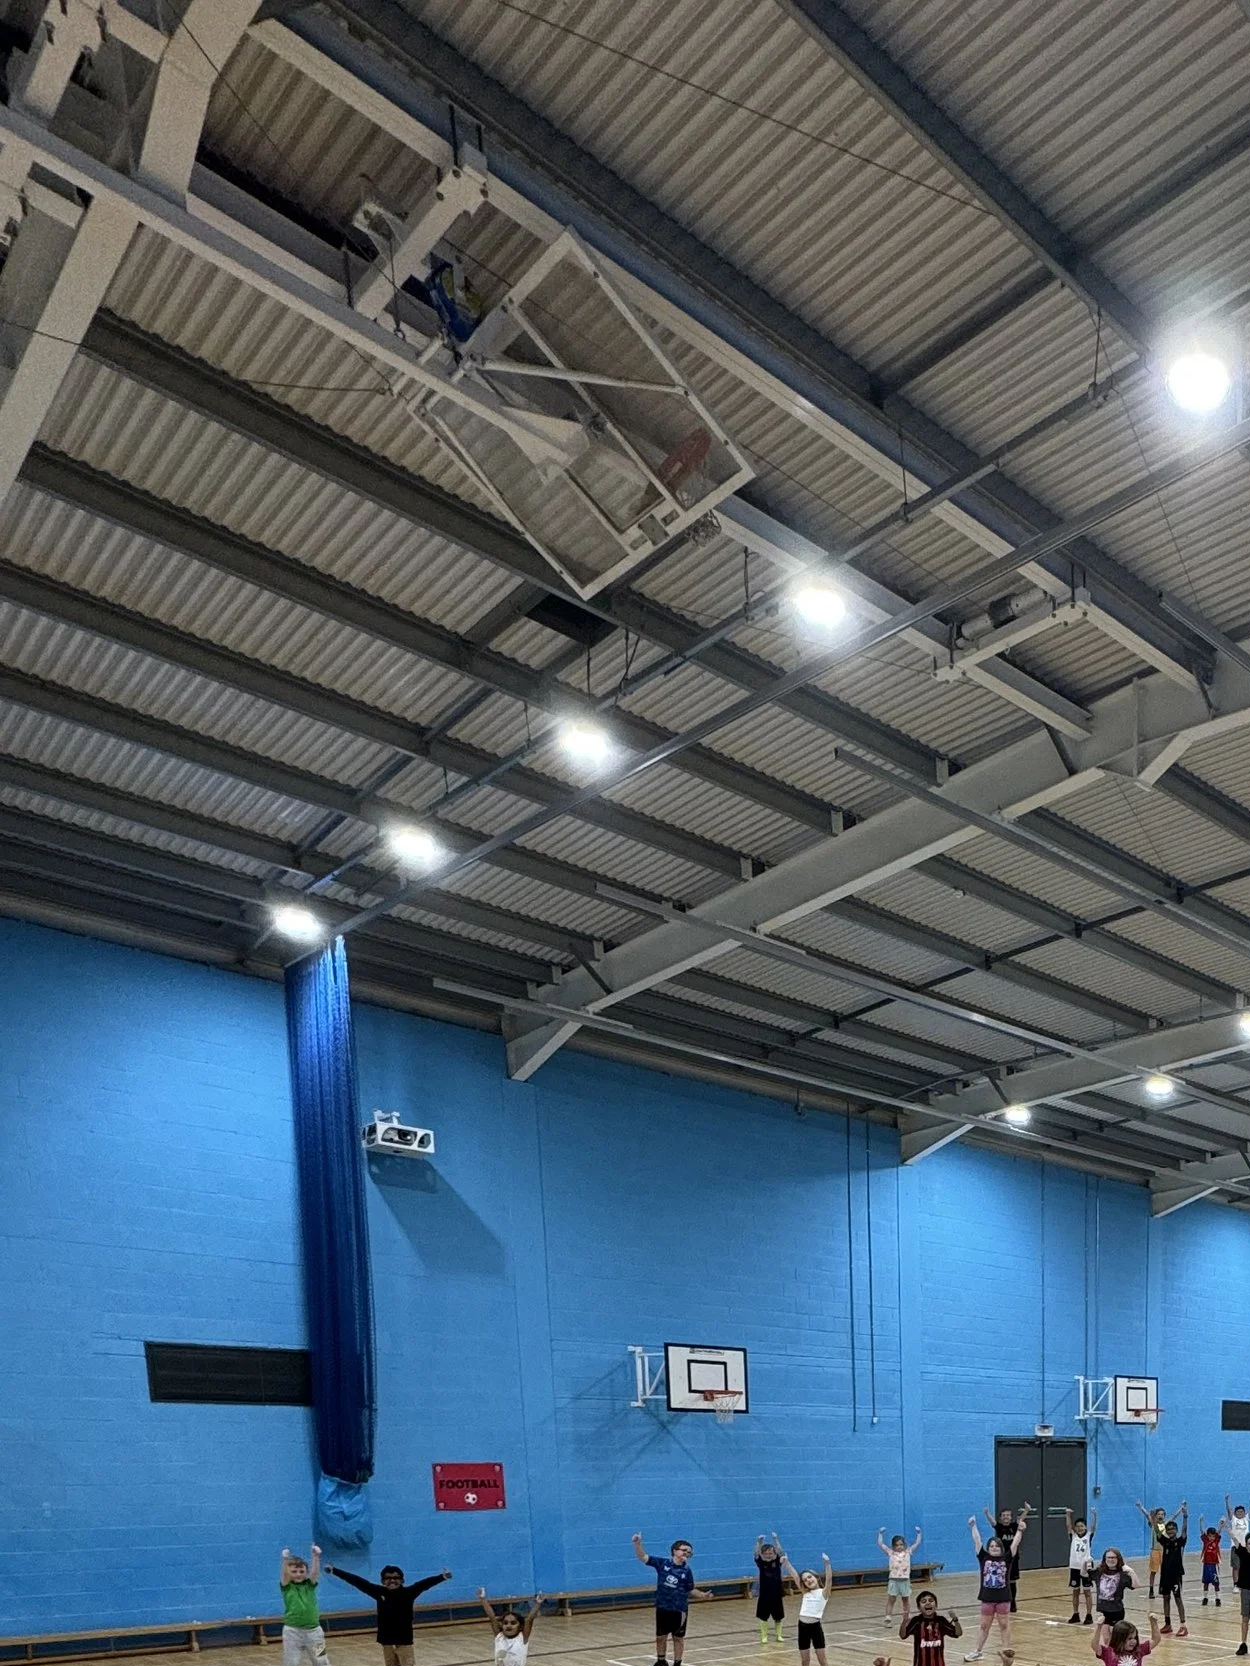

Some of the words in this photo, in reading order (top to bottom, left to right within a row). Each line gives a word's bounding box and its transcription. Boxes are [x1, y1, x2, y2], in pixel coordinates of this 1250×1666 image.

[439, 1479, 500, 1489] FOOTBALL
[1076, 1544, 1085, 1553] 24
[920, 1639, 942, 1648] bwin
